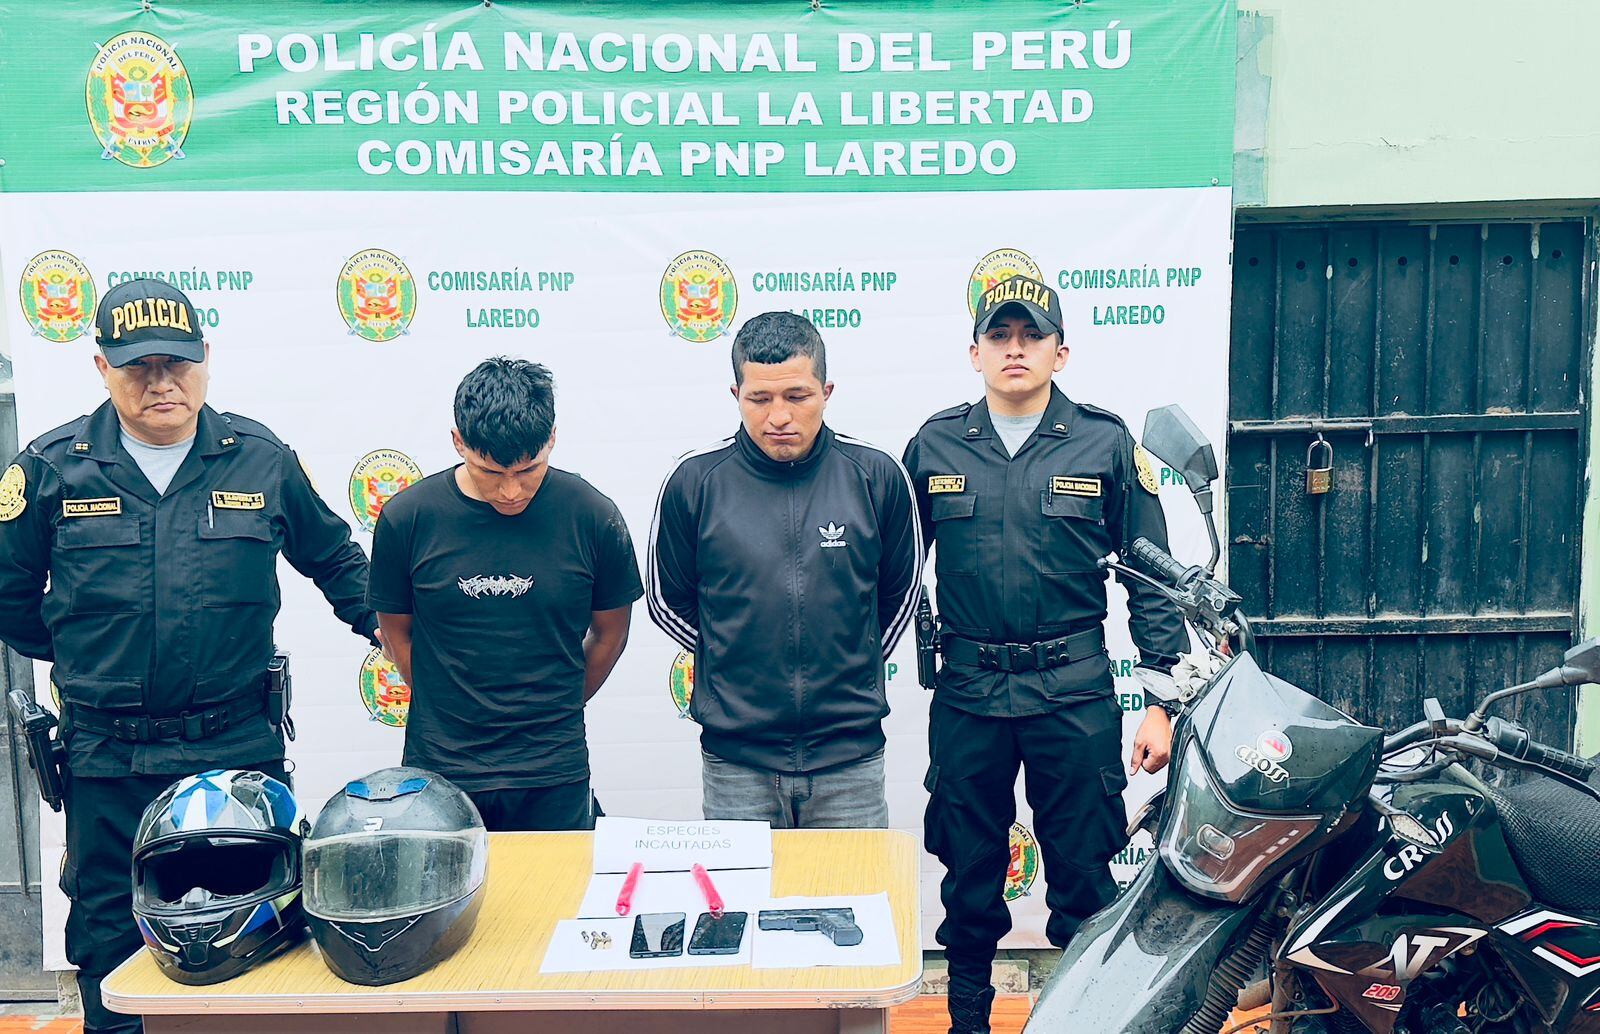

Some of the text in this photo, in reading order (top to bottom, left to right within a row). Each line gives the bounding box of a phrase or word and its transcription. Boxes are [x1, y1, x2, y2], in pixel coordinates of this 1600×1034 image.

[96, 36, 177, 71] POLICIA NACIONAL
[238, 20, 1131, 73] POLICÍA NACIONAL DEL PERÚ
[275, 81, 1094, 126] REGIÓN POLICIAL LA LIBERTAD
[357, 132, 1017, 177] COMISARÍA PNP LAREDO
[216, 271, 253, 290] PNP
[427, 267, 575, 291] COMISARÍA PNP
[752, 267, 897, 292] COMISARÍA PNP
[1057, 264, 1202, 290] COMISARÍA PNP
[984, 279, 1051, 313] POLICIA
[111, 297, 193, 340] POLICIA
[466, 308, 540, 328] LAREDO
[1093, 305, 1165, 326] LAREDO
[67, 503, 90, 512] POLICIA
[820, 539, 847, 548] adidas
[1236, 746, 1288, 781] CROSS
[646, 825, 721, 836] ESPECIES
[635, 838, 732, 850] INCAUTADAS
